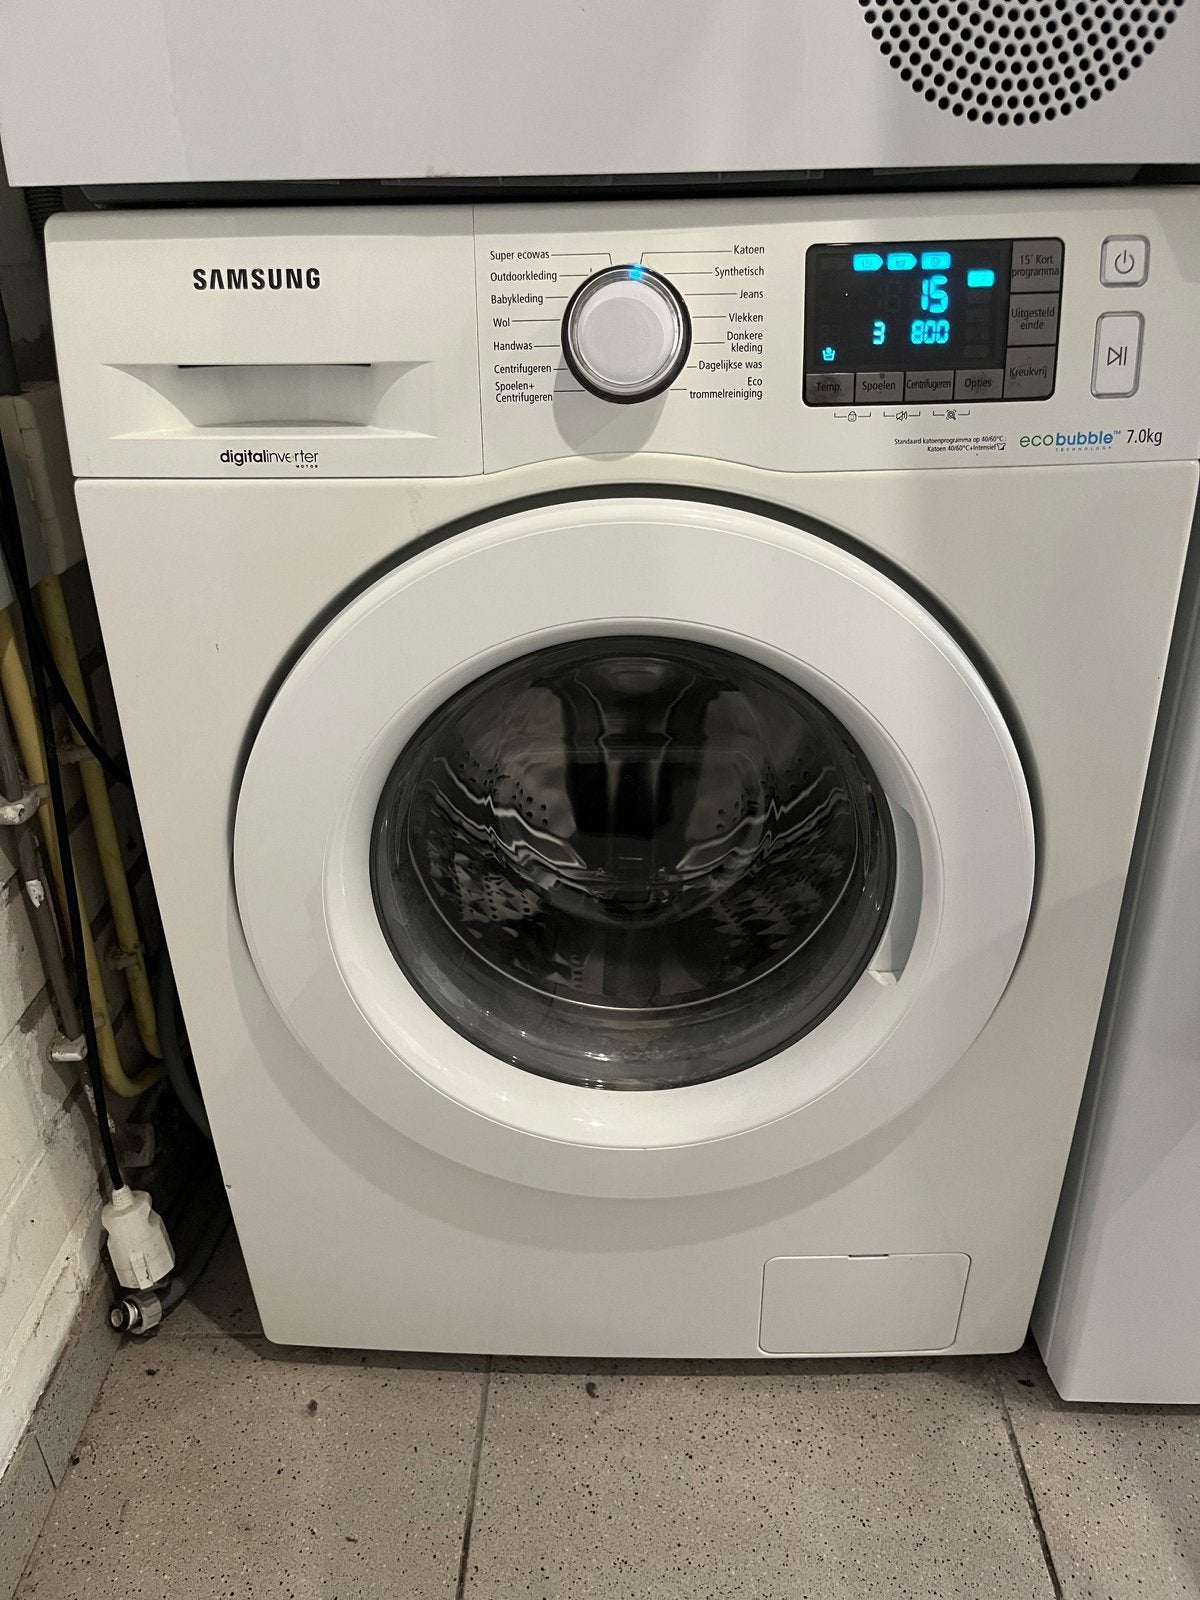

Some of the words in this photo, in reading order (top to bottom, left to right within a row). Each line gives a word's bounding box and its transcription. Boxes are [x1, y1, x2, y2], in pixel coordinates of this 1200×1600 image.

[490, 250, 515, 261] Super
[517, 250, 550, 260] ecowas
[733, 244, 765, 255] Katoen
[1036, 254, 1053, 265] Kort
[490, 270, 558, 283] Outdoorkleding
[714, 266, 765, 278] Synthetisch
[1011, 267, 1060, 279] programma
[193, 267, 321, 290] SAMSUNG
[491, 293, 544, 306] Babykleding
[739, 289, 764, 300] Jeans
[920, 274, 949, 314] 15
[729, 312, 764, 323] Vlekken
[1011, 307, 1055, 321] Uitgesteld
[493, 317, 511, 328] Wol
[1020, 319, 1044, 330] einde
[727, 330, 763, 341] Donkere
[872, 320, 887, 345] 3
[911, 319, 950, 345] 800
[493, 340, 533, 351] Handwas
[731, 342, 763, 354] kleding
[494, 363, 552, 376] Centrifugeren
[698, 359, 743, 371] Dagelijkse
[744, 361, 763, 370] was
[1009, 366, 1048, 379] Kreukvrij
[495, 381, 535, 393] Spoelen+
[747, 376, 763, 386] Eco
[862, 380, 896, 392] Spoelen
[906, 378, 952, 391] Centrifugeren
[964, 377, 992, 388] Opties
[816, 382, 842, 393] Temp.
[495, 392, 553, 404] Centrifugeren
[689, 388, 763, 400] trommelreiniging
[922, 436, 972, 445] katoenprogramma
[1126, 428, 1163, 446] 7.0kg
